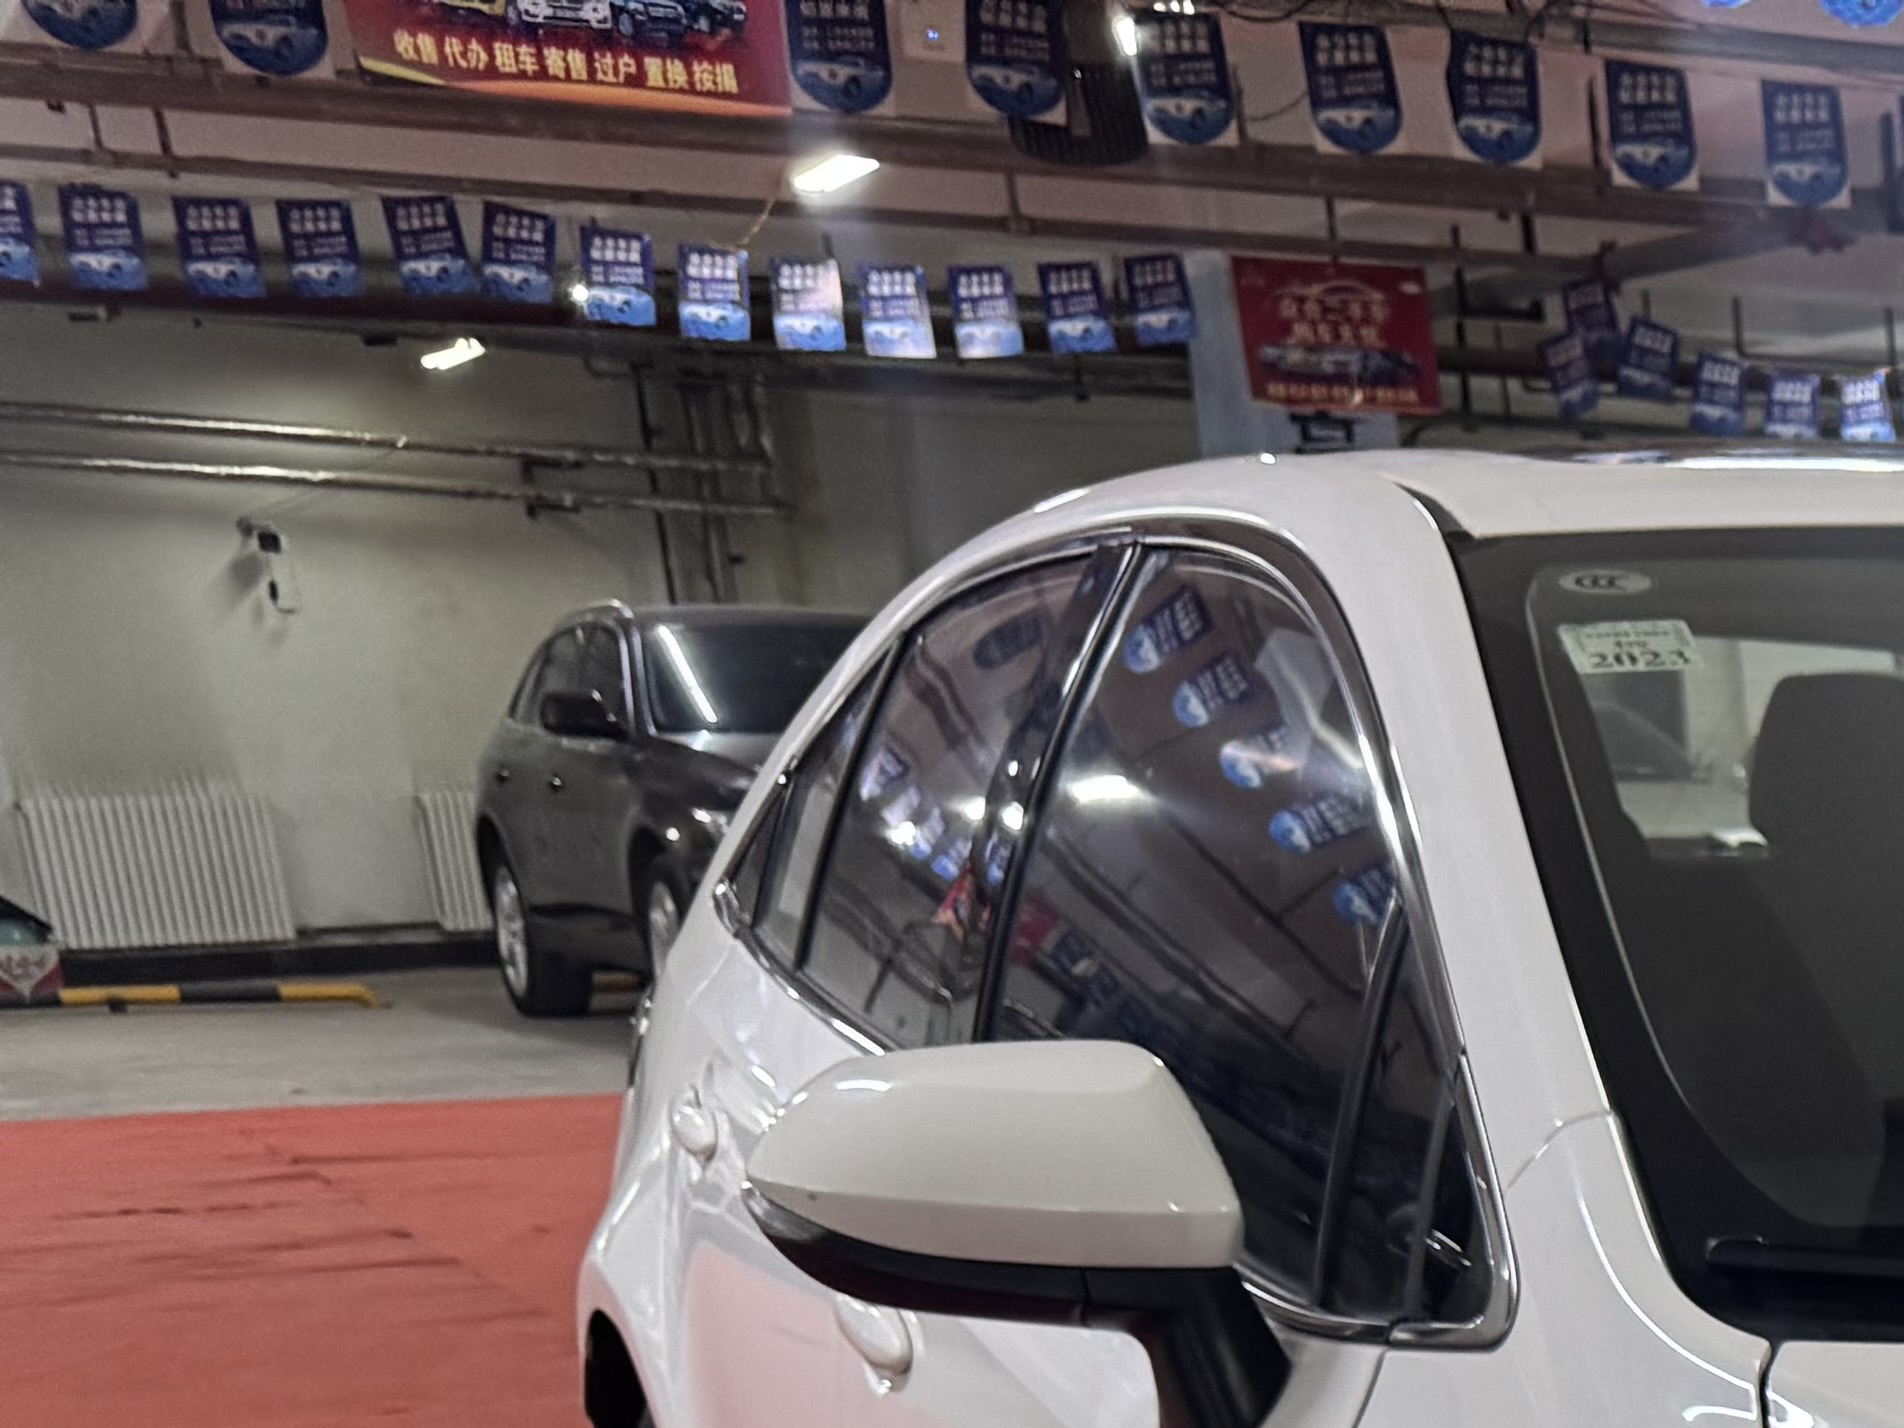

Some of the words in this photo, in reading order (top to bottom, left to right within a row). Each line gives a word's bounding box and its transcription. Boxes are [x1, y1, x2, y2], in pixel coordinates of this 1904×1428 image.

[444, 36, 488, 71] 代办
[495, 41, 538, 76] 租车
[543, 46, 588, 81] 寄售
[594, 51, 637, 83] 过户
[644, 56, 688, 89] 置换
